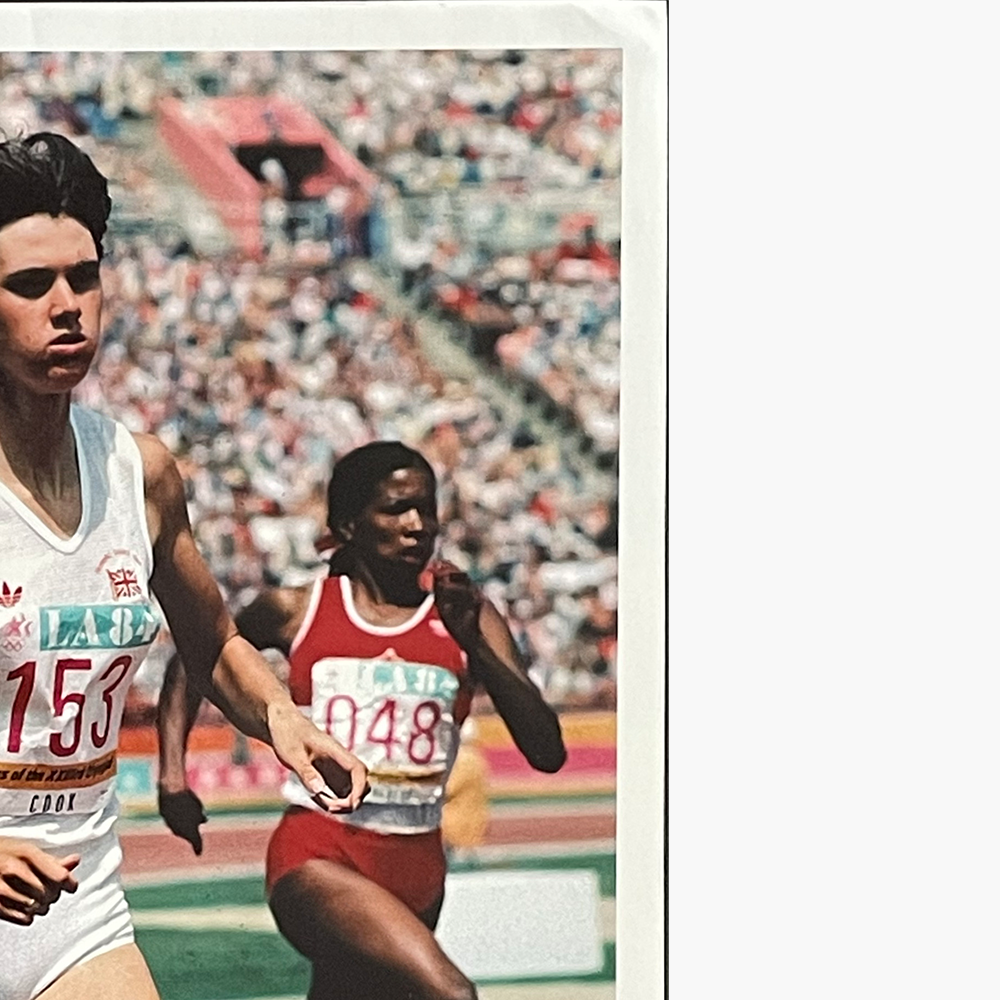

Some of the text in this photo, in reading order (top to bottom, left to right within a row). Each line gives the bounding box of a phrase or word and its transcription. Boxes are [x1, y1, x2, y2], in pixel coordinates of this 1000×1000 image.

[47, 607, 102, 648] LA
[6, 655, 133, 757] 153
[326, 694, 441, 765] 048
[10, 767, 27, 781] of
[29, 792, 77, 813] COOK
